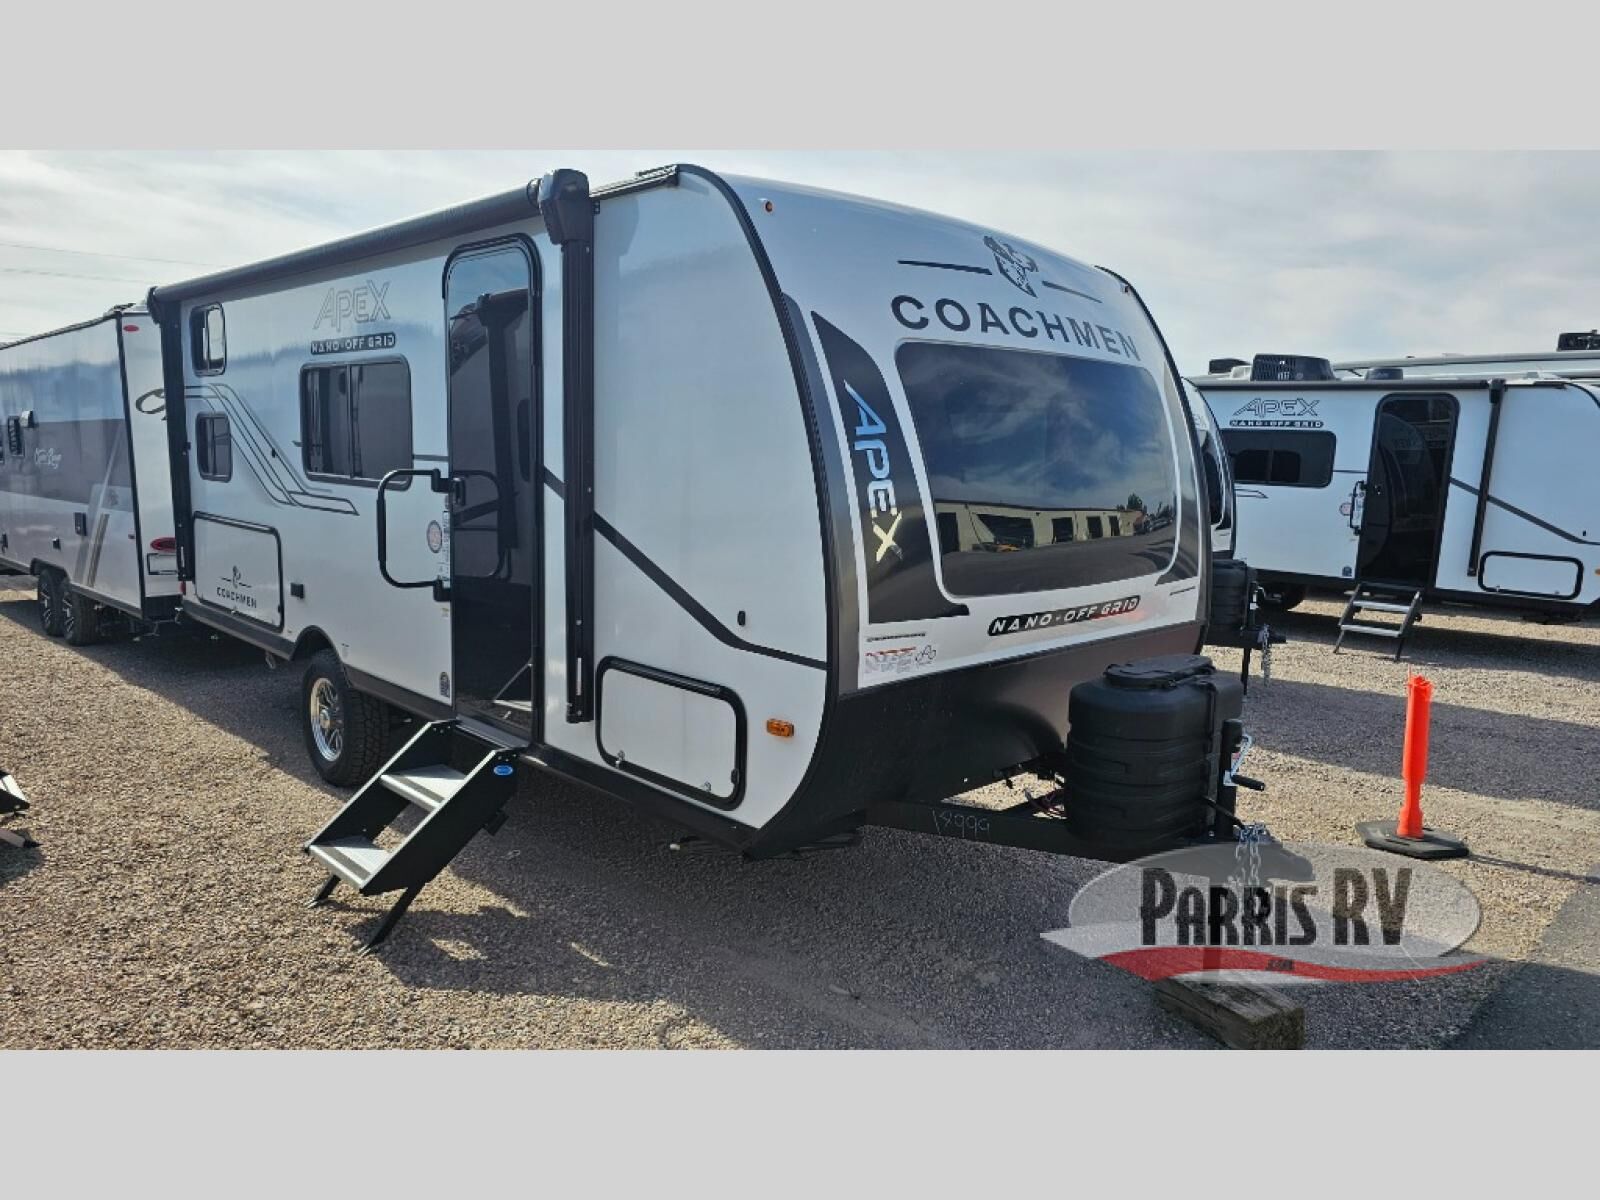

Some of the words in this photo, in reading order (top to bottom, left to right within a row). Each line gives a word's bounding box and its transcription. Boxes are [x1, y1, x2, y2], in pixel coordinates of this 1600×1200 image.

[312, 279, 392, 333] APEX
[890, 294, 1141, 362] COACHMEN
[368, 335, 395, 348] GRID
[1232, 397, 1321, 419] APEX
[843, 379, 904, 562] APEX
[216, 586, 257, 609] COACHMEN
[1101, 597, 1139, 615] GRID
